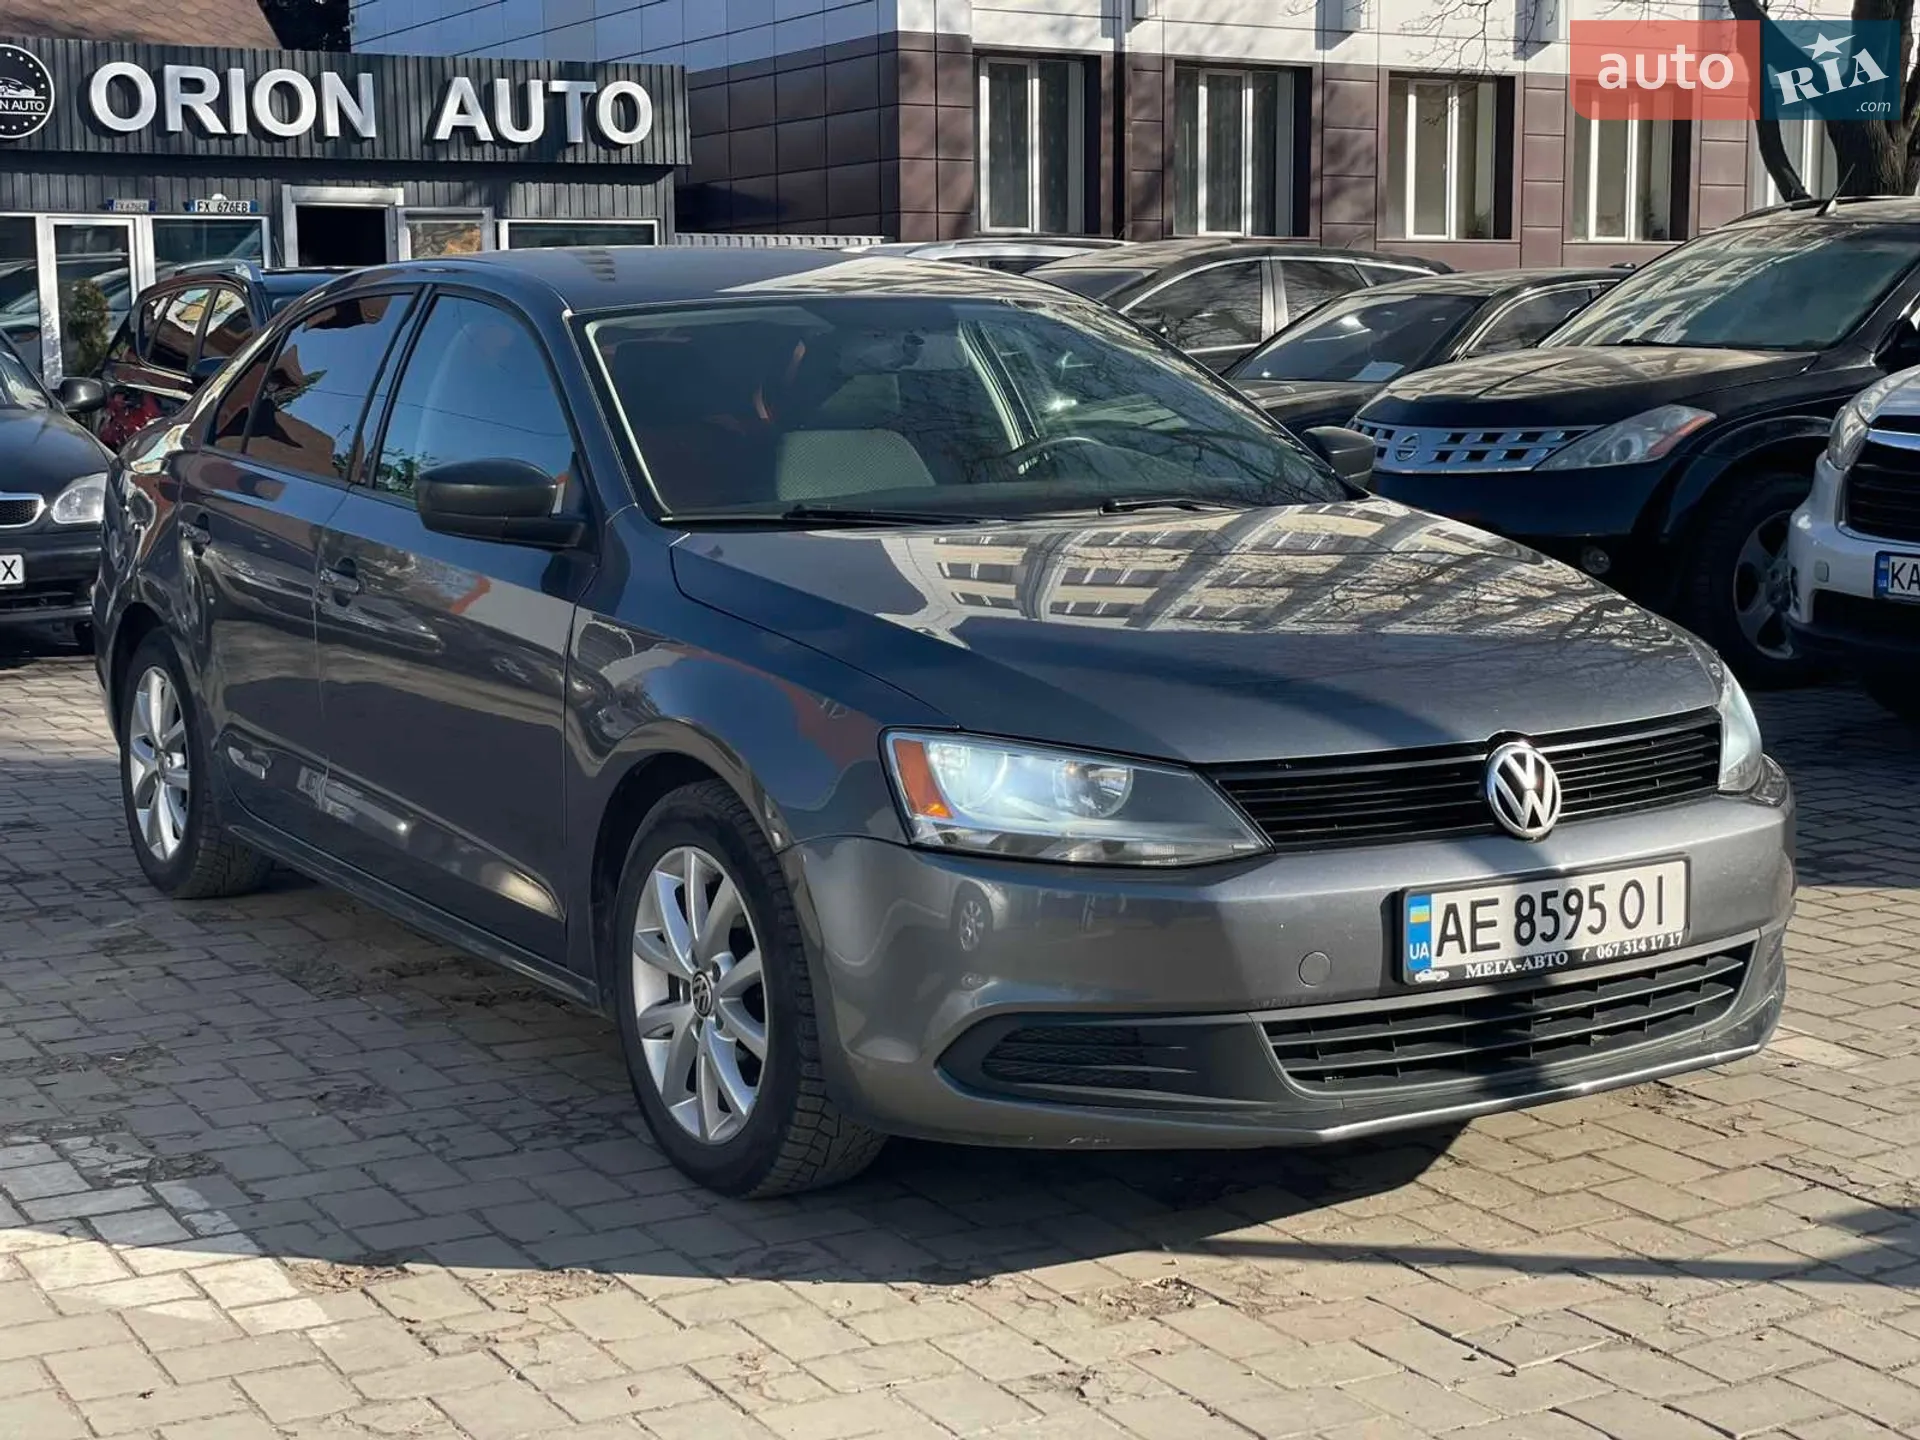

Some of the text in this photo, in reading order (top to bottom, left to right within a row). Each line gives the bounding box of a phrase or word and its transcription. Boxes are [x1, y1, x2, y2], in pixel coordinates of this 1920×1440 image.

[11, 100, 45, 111] AUTO
[89, 62, 653, 146] ORION AUTO
[1436, 898, 1501, 958] AE
[1514, 884, 1607, 947] 8595
[1410, 943, 1430, 959] UA
[1465, 951, 1569, 979] МЕГА-АВТО
[1597, 942, 1622, 961] 067
[1624, 937, 1648, 957] 314
